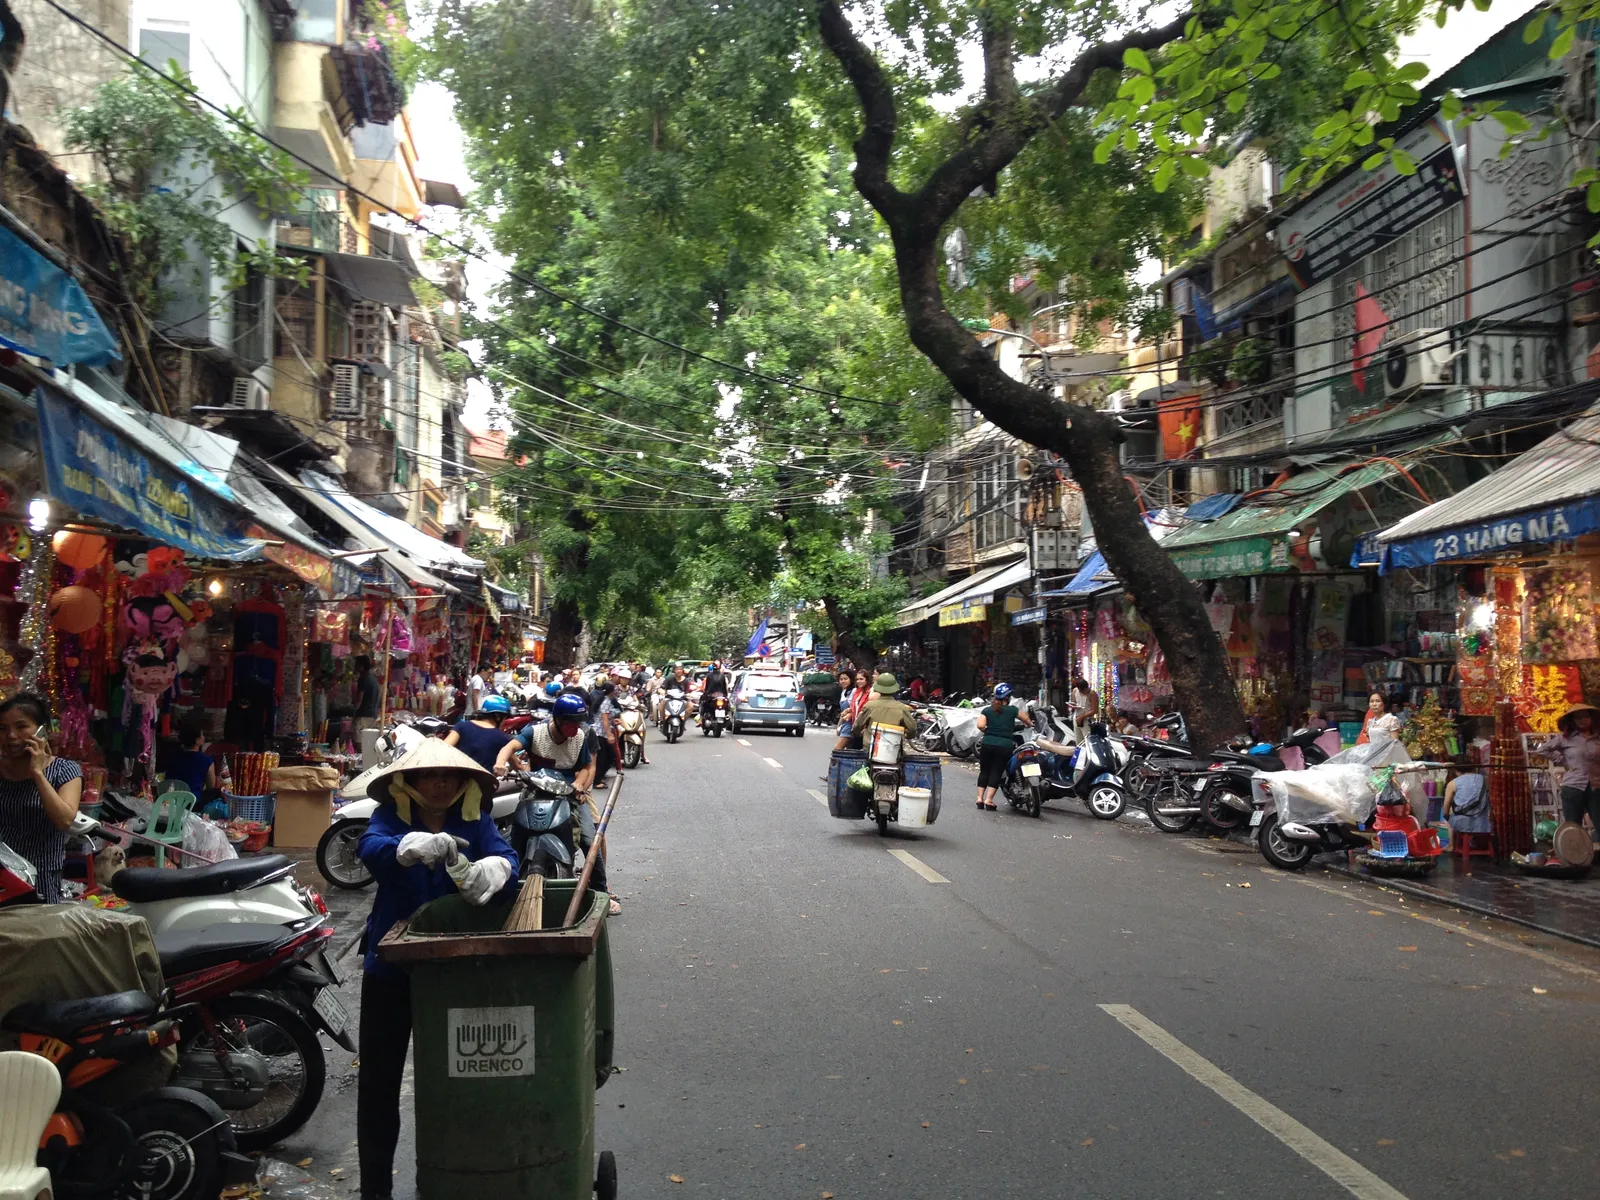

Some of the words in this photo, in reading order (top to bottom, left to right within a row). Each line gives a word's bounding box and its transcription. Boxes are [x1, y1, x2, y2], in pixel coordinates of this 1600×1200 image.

[1434, 534, 1459, 559] 23
[1465, 523, 1523, 553] HÀNG
[1528, 508, 1569, 541] MÃ
[456, 1058, 524, 1073] URENCO
